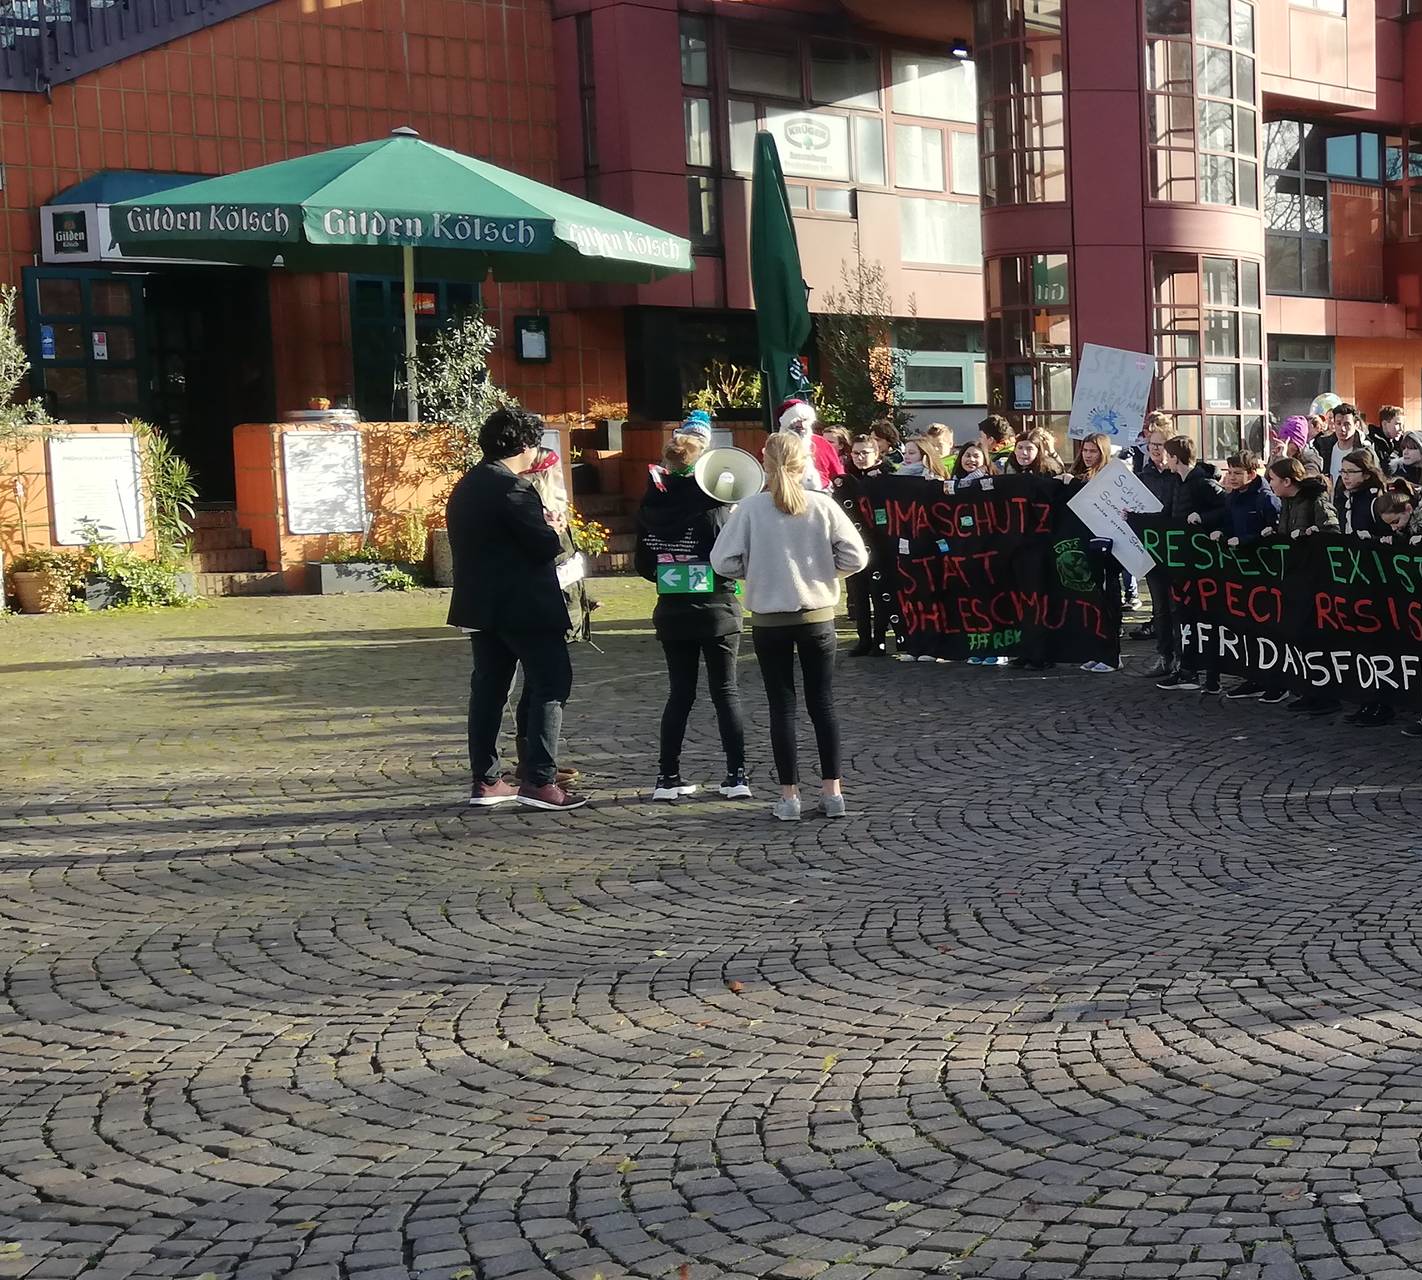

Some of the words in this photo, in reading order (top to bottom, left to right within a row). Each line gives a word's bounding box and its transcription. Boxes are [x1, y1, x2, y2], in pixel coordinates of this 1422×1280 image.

[56, 230, 85, 242] Gilden
[127, 206, 201, 232] Gilden
[209, 204, 289, 236] Kölsch
[323, 208, 423, 238] Gilden
[432, 211, 535, 247] Kölsch
[622, 230, 680, 261] Kölsch
[896, 550, 1000, 595] STATT
